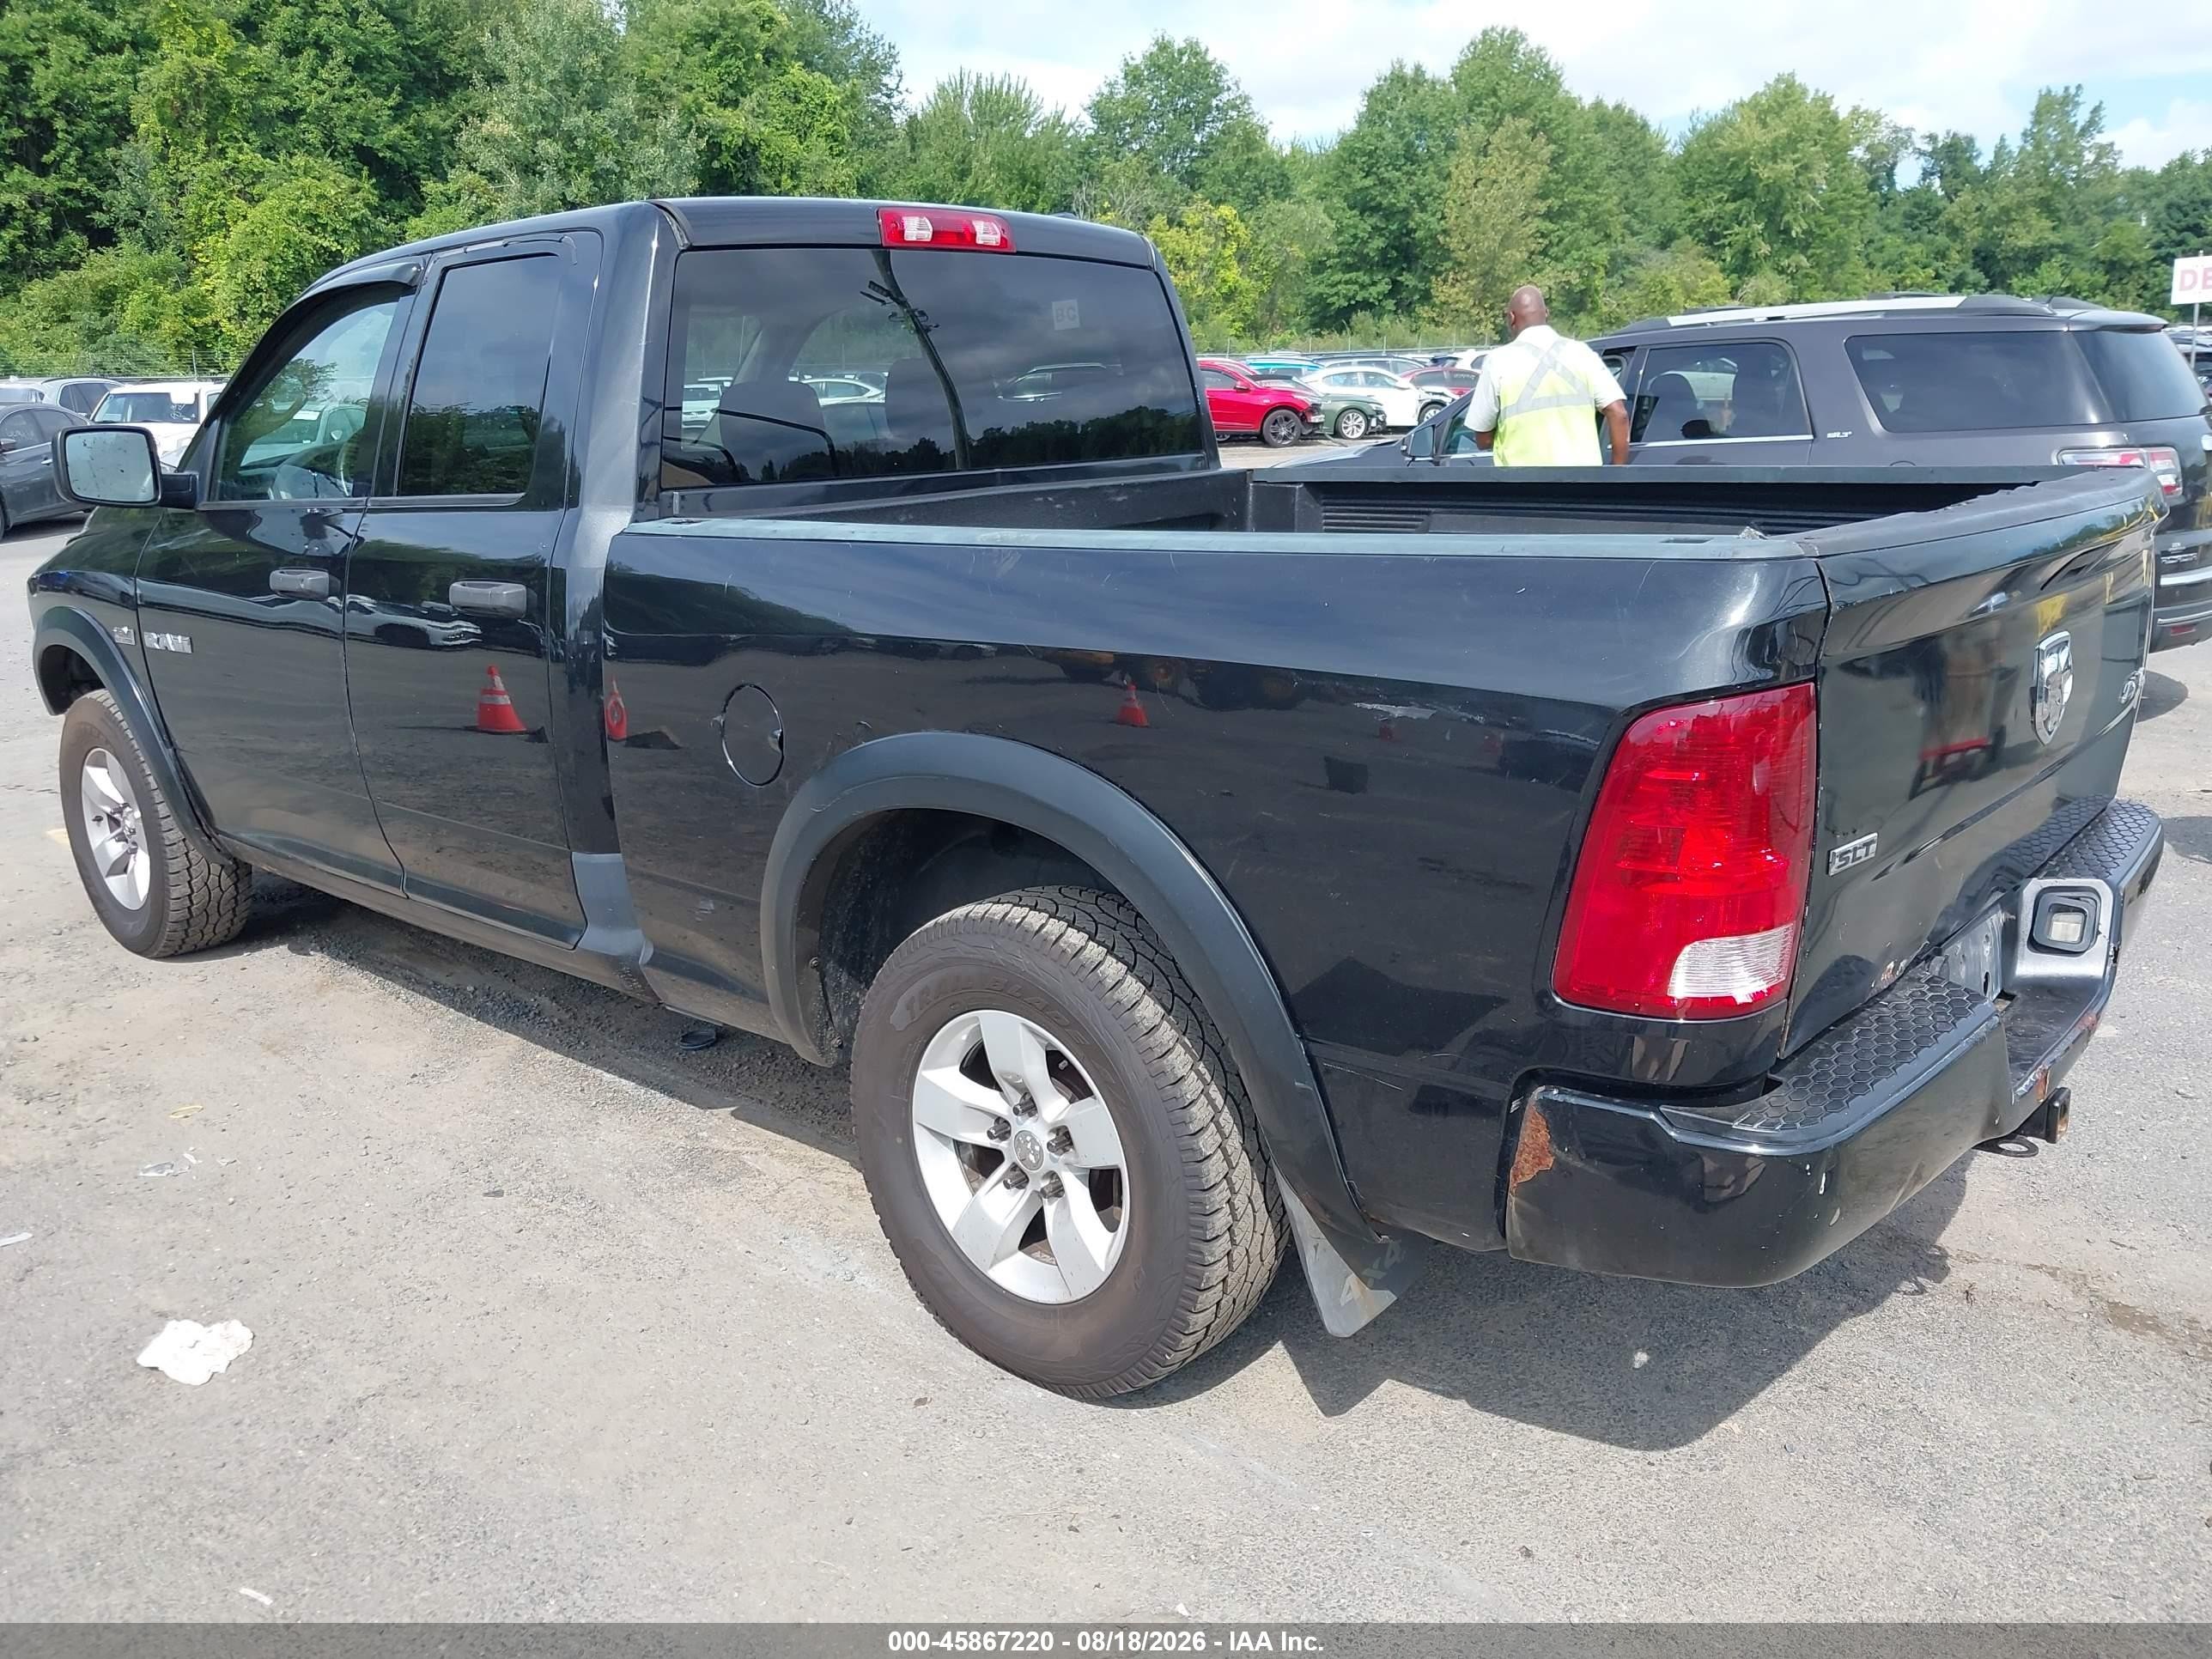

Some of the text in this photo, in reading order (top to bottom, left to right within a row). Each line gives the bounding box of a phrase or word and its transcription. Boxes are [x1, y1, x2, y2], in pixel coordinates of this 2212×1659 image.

[143, 631, 193, 653] RAM
[1833, 837, 1877, 871] SLT
[983, 975, 1096, 1046] BLADE
